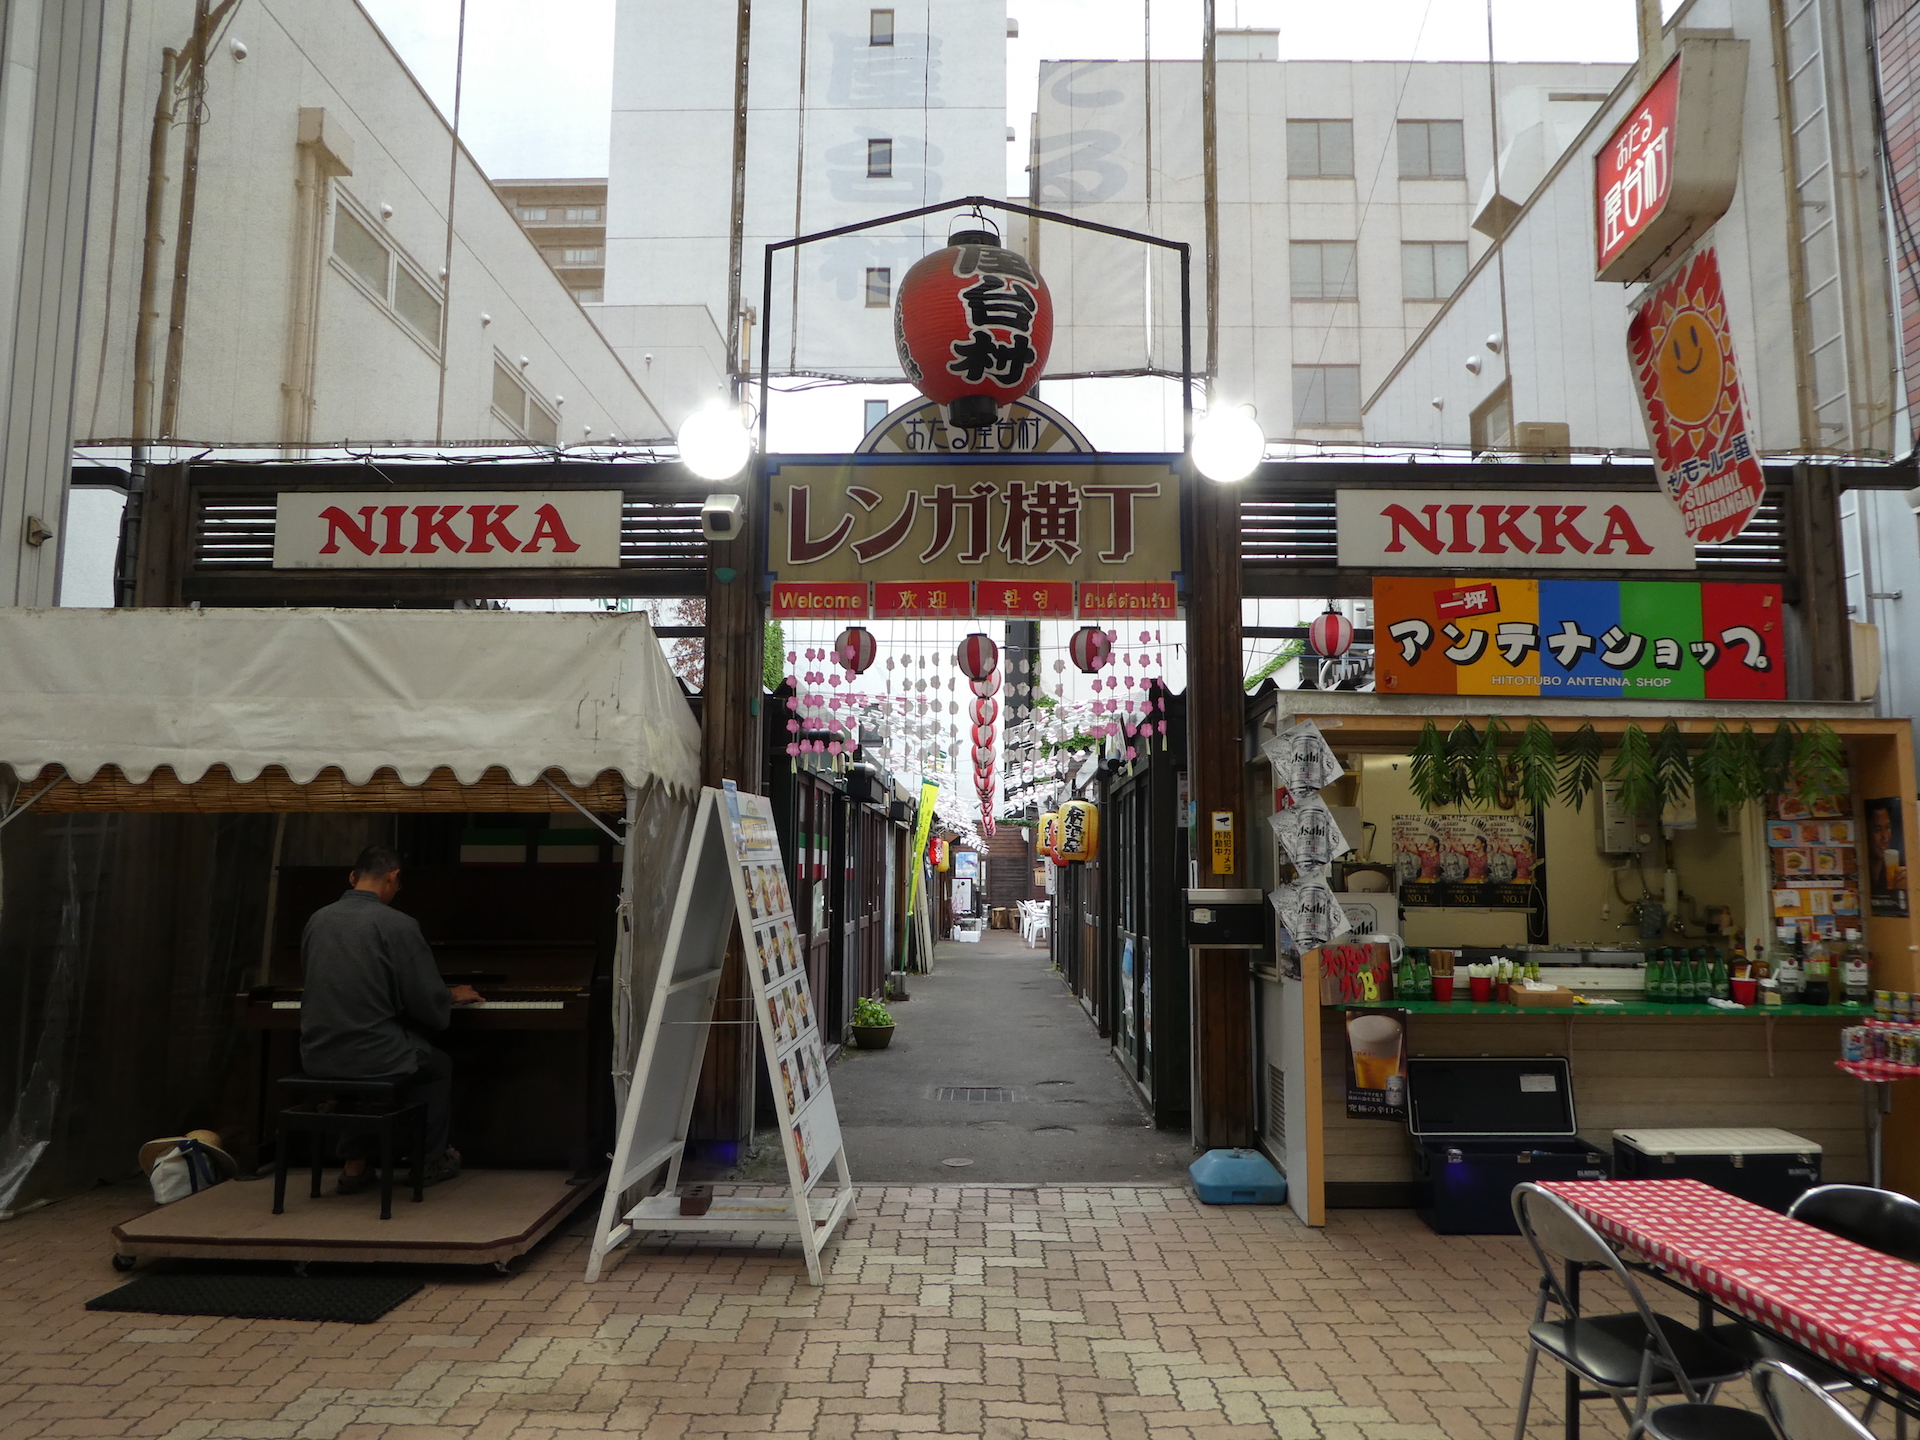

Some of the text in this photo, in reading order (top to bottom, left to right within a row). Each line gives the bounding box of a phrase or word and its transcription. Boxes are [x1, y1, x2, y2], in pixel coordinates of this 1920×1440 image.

[1616, 108, 1653, 171] おたる
[1602, 126, 1669, 257] 屋台村
[947, 245, 1039, 388] 屋台村
[1684, 470, 1743, 510] SUNMALL
[319, 503, 580, 555] NIKKA
[788, 480, 1161, 566] レンガ横丁
[1380, 503, 1655, 555] NIKKA
[779, 592, 862, 609] Welcome
[1440, 589, 1489, 611] 一坪
[1388, 618, 1772, 673] アンテナショップ
[1491, 675, 1671, 688] HITOTUBO ANTENNA SHOP
[1291, 751, 1320, 764] Asahi
[1297, 824, 1325, 837] Asahi
[1214, 831, 1223, 856] 作動中
[1223, 831, 1232, 873] 防犯カメラ
[1297, 902, 1326, 915] Asahi
[1407, 894, 1428, 903] NO.1
[1454, 894, 1476, 903] NO.1
[1502, 894, 1524, 903] NO.1
[1348, 921, 1373, 936] sahi
